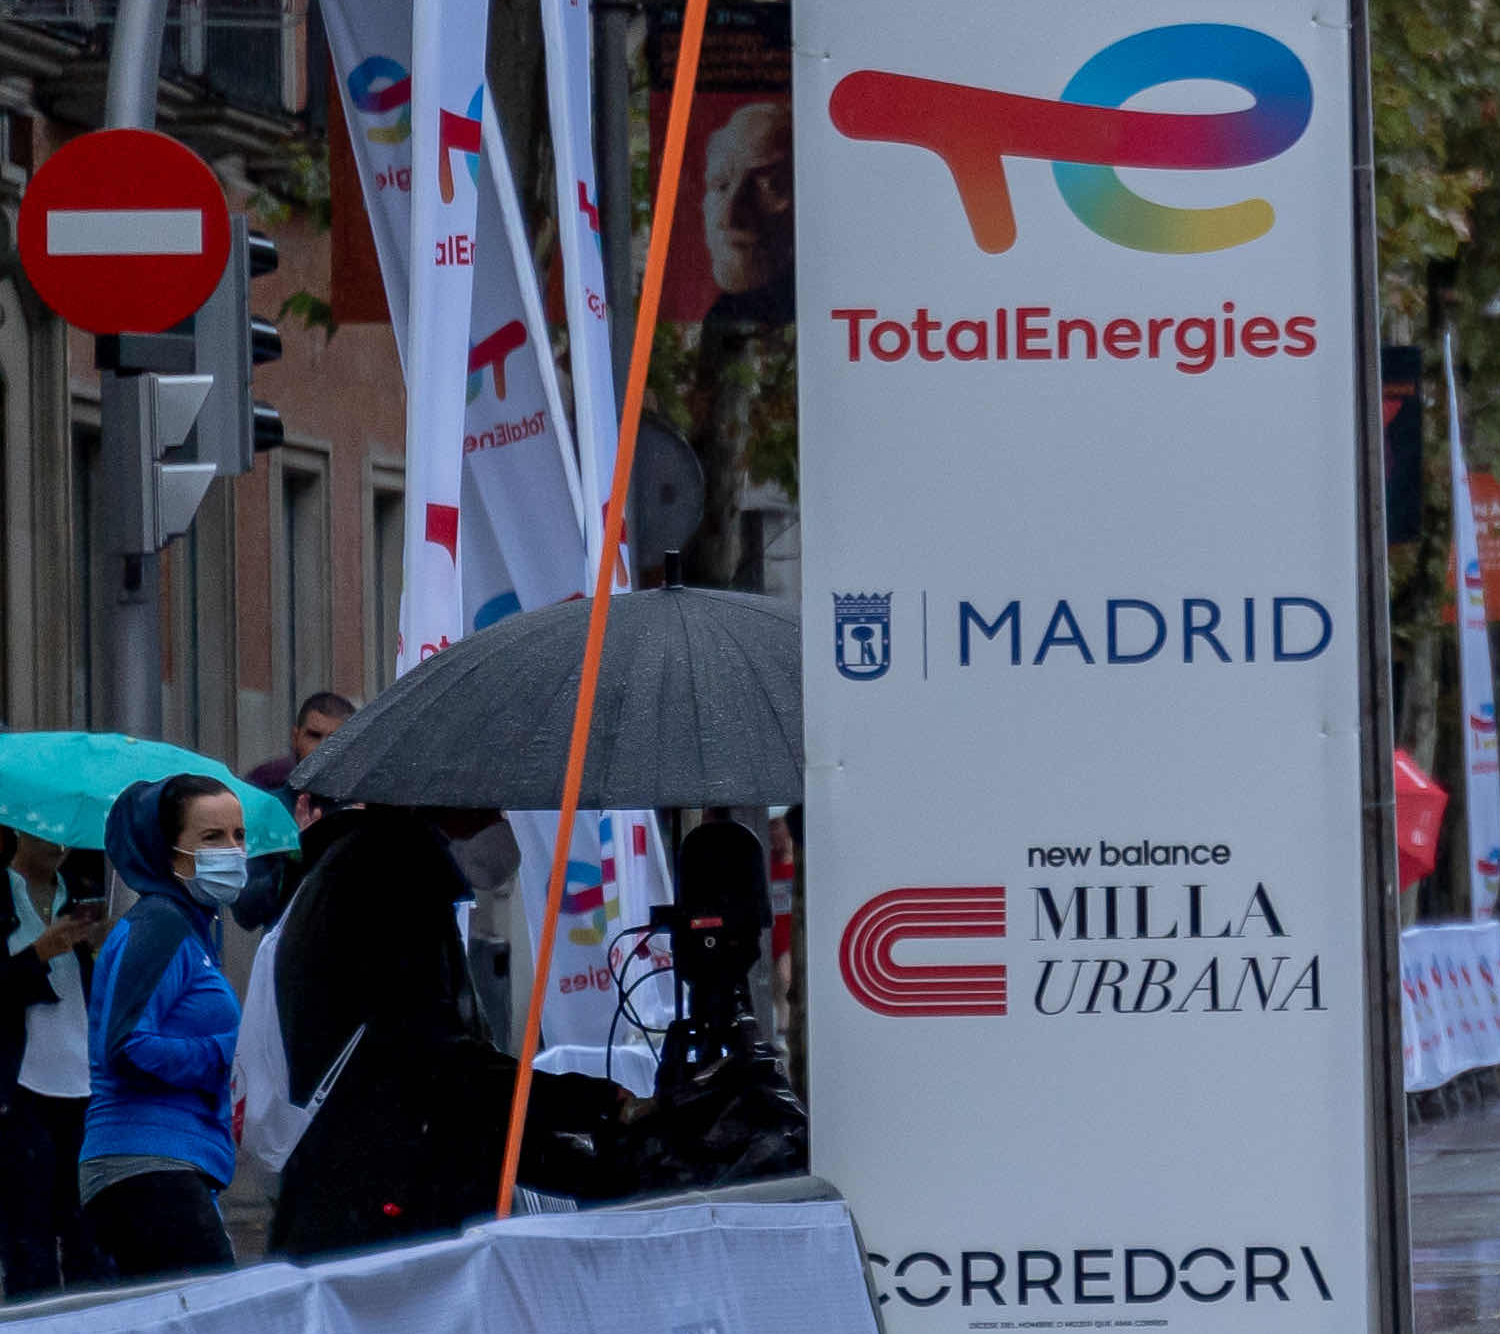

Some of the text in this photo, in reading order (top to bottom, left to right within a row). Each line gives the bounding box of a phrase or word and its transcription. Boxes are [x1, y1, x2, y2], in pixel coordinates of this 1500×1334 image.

[832, 302, 1316, 374] TotalEnergies
[960, 597, 1332, 666] MADRID
[1028, 840, 1230, 867] new balance
[1030, 882, 1291, 940] MILLA
[1034, 955, 1328, 1015] URBANA
